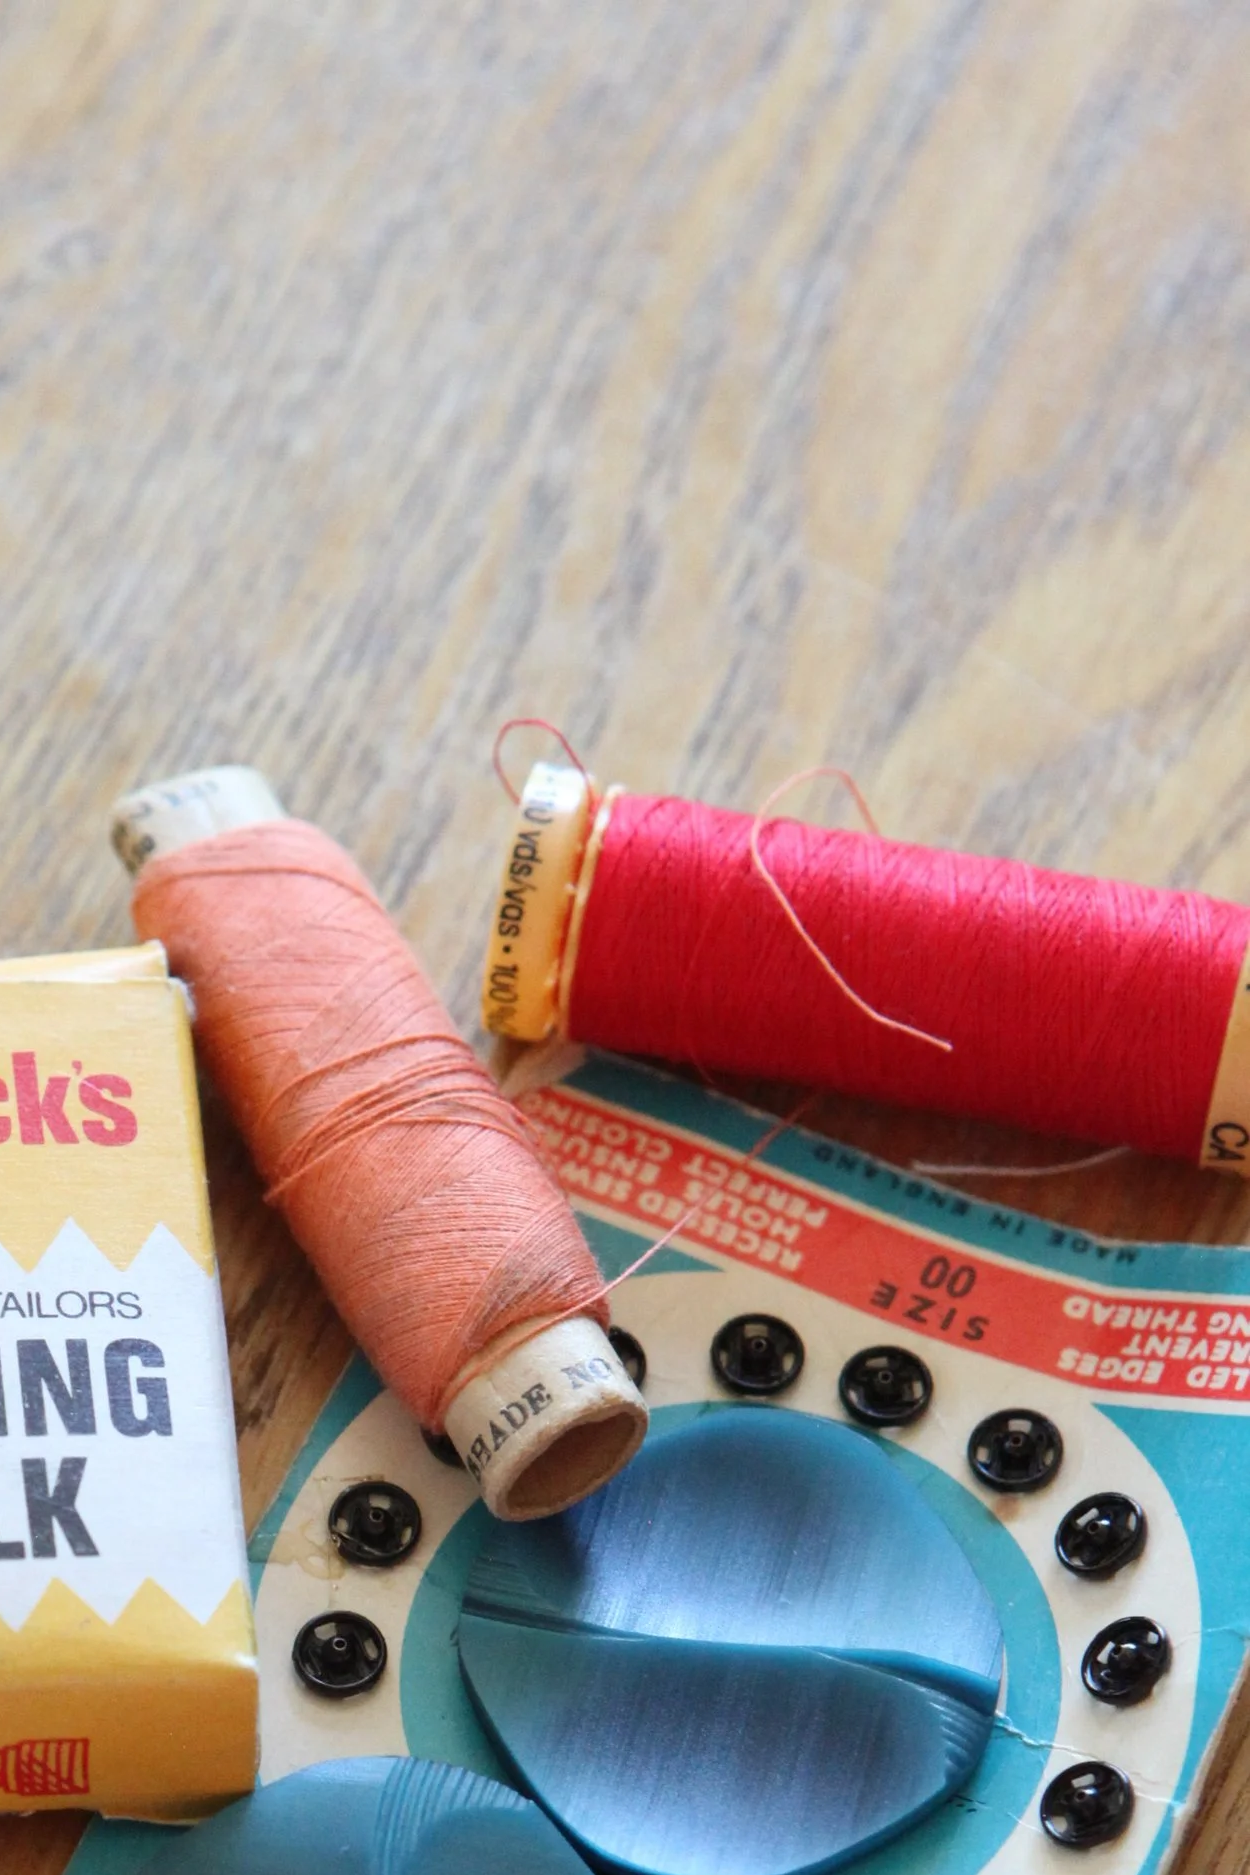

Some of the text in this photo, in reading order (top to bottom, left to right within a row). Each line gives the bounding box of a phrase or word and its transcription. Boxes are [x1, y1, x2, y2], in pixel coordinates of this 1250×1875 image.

[681, 1153, 829, 1229] PERFECT
[813, 1143, 1141, 1264] MADE IN ENGLAND
[919, 1255, 978, 1300] 00
[869, 1280, 990, 1341] SIZE
[1062, 1295, 1198, 1333] THREAD
[1056, 1347, 1165, 1385] EDGES
[1120, 1331, 1250, 1365] REVENT
